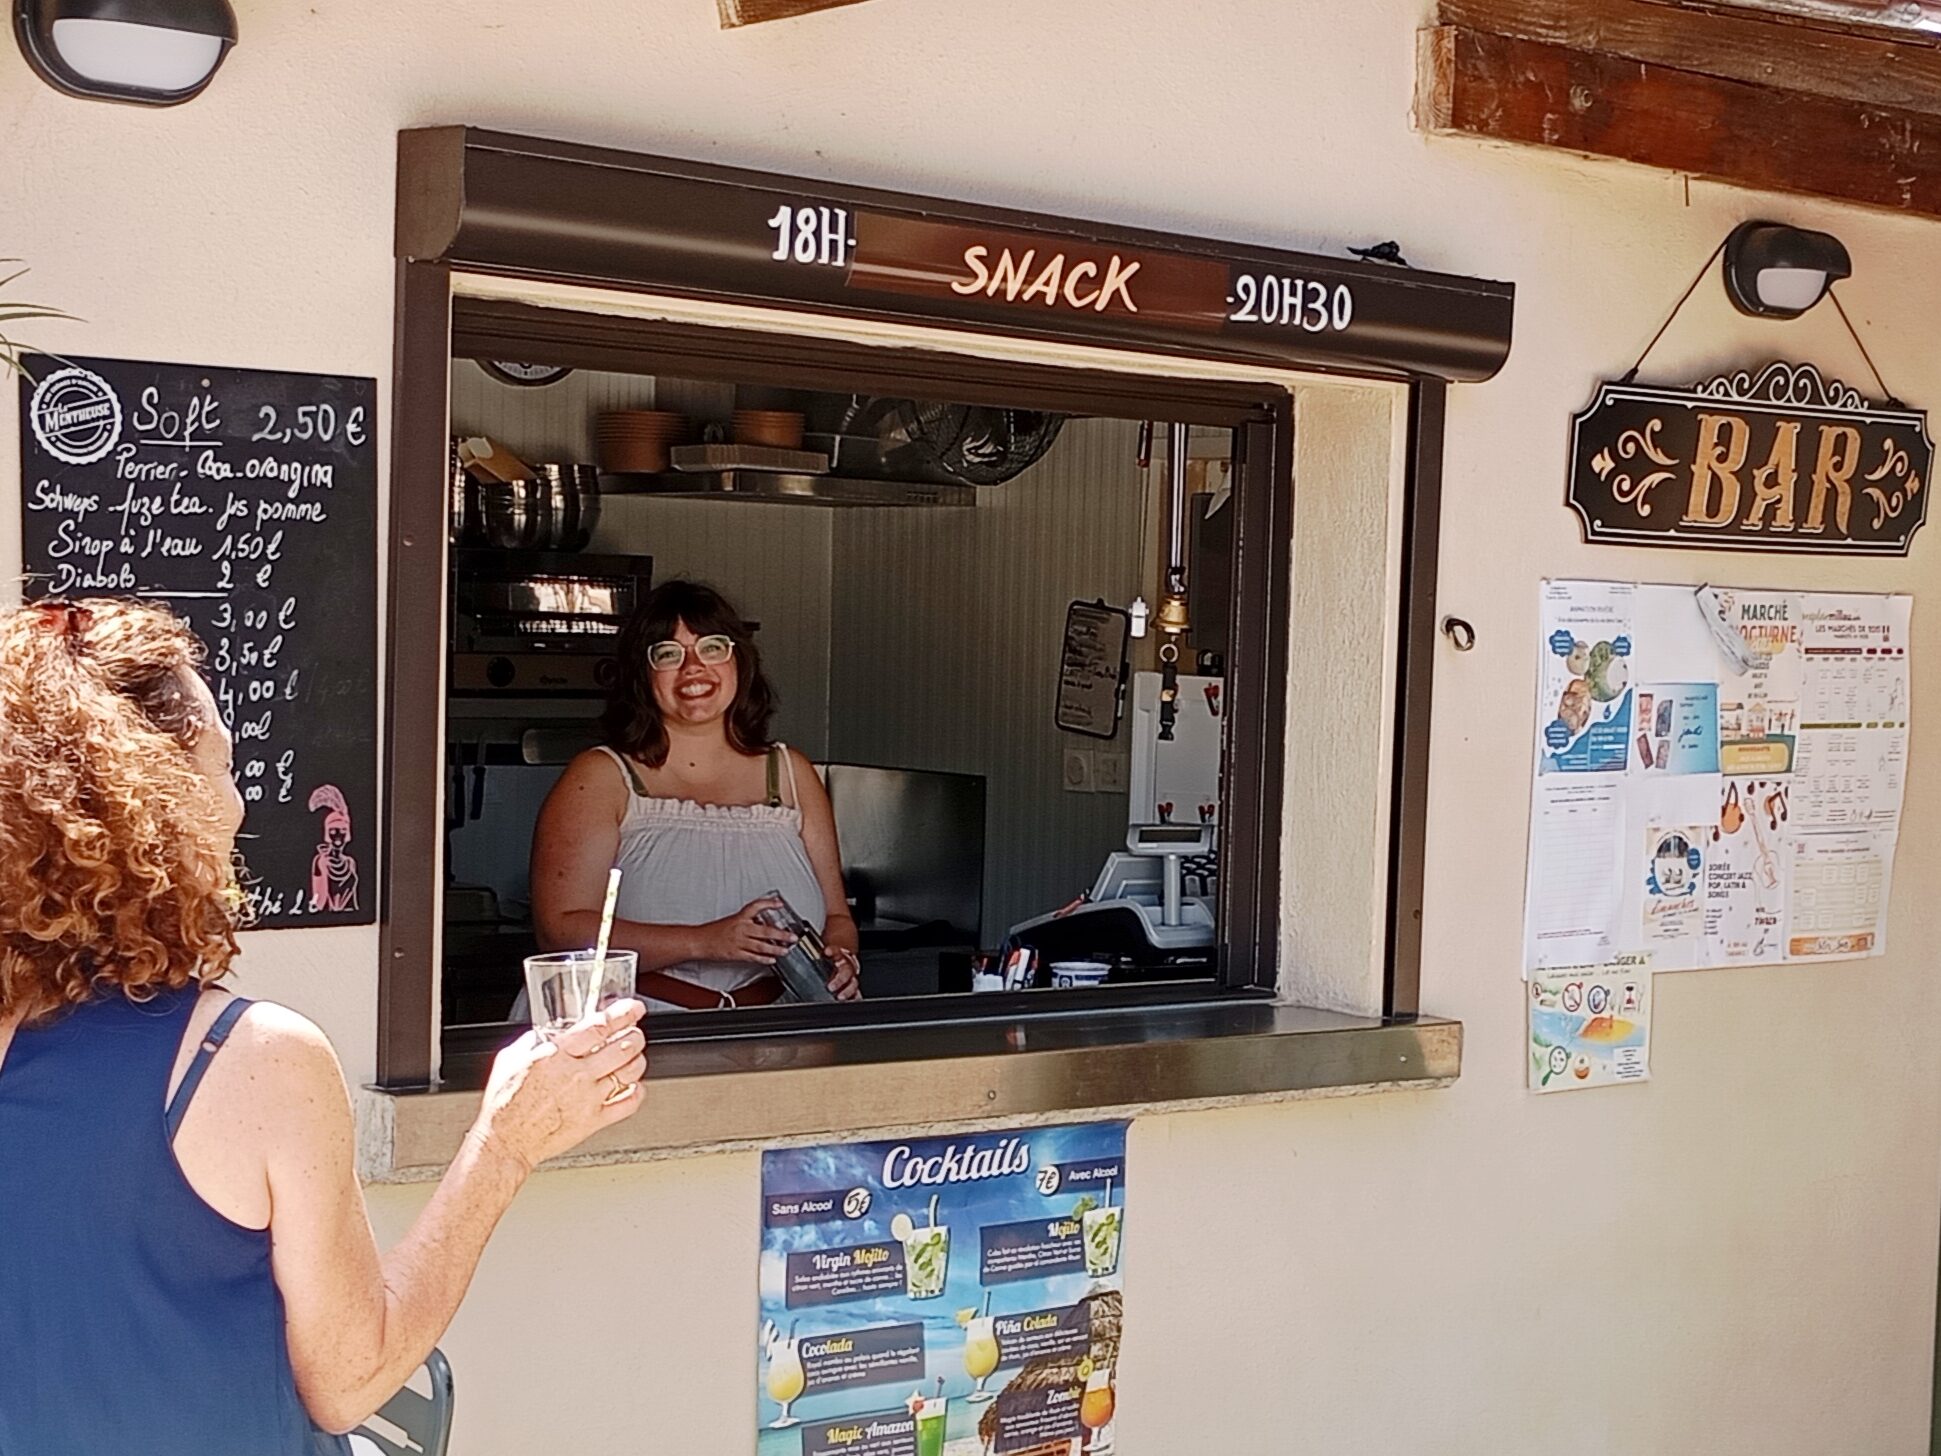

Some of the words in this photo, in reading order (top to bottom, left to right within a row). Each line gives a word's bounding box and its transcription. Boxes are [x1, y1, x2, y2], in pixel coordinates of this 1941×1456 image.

[951, 245, 1141, 313] SNACK
[132, 386, 220, 451] Soft
[252, 403, 335, 443] 2,50
[1679, 413, 1862, 535] BAR
[255, 499, 327, 532] pomme
[48, 519, 113, 568] Sirop
[120, 528, 136, 554] à
[141, 528, 203, 558] l'eau
[216, 560, 234, 589] 2
[211, 603, 268, 632] 3,00
[1741, 598, 1788, 621] MARCHÉ
[882, 1137, 1029, 1189] Cocktails
[1068, 1170, 1092, 1181] Avec
[1092, 1165, 1119, 1179] Alcool
[772, 1203, 799, 1216] Sans
[801, 1199, 833, 1214] Alcool
[1047, 1221, 1081, 1240] Mojito
[812, 1252, 852, 1272] Virgin
[853, 1247, 890, 1268] Mojito
[1023, 1314, 1058, 1332] Colada
[802, 1338, 854, 1359] Cocolada
[826, 1425, 864, 1446] Magic
[865, 1419, 914, 1439] Amazon
